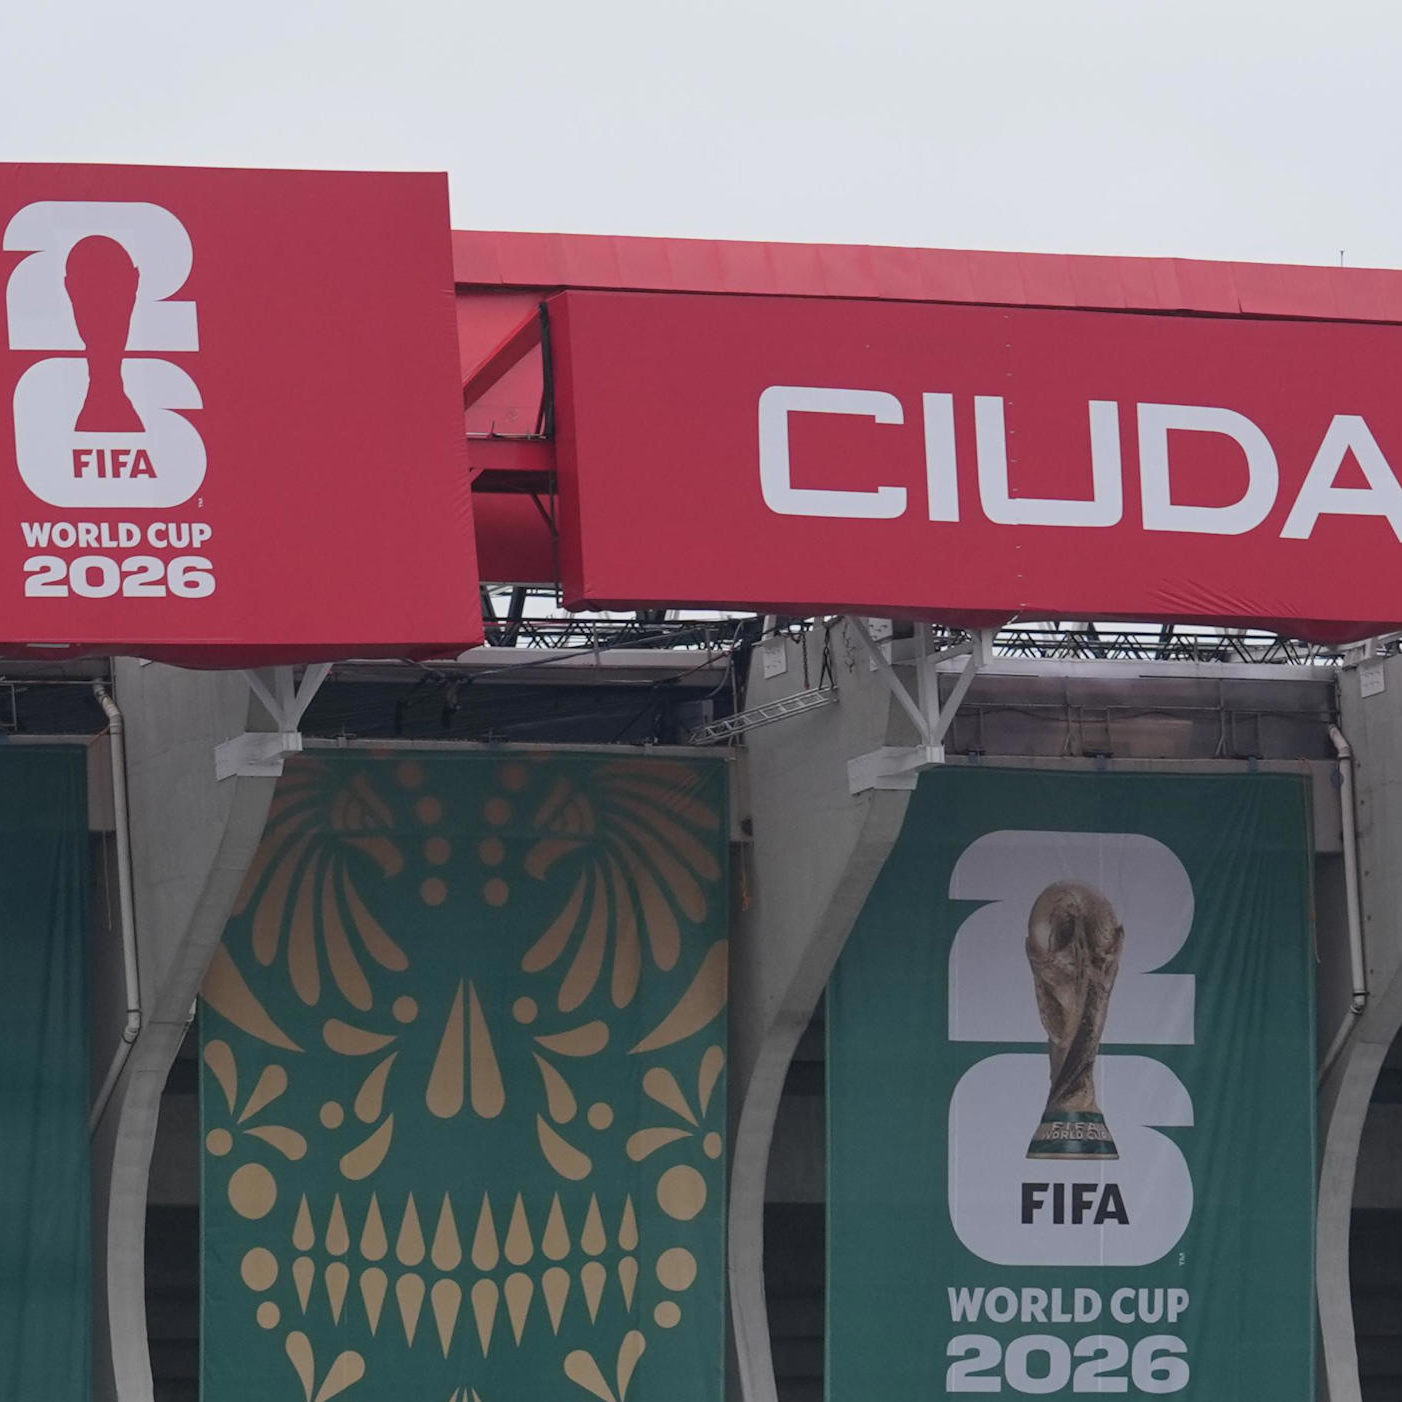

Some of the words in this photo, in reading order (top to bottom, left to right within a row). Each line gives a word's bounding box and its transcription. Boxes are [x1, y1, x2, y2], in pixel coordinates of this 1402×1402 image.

[72, 448, 158, 479] FIFA
[21, 522, 141, 549] WORLD
[146, 522, 212, 549] CUP
[22, 555, 216, 598] 2026
[1052, 1122, 1097, 1130] FIFA
[1021, 1183, 1130, 1225] FIFA
[947, 1287, 1103, 1323] WORLD
[1110, 1287, 1190, 1324] CUP
[945, 1333, 1190, 1394] 2026
